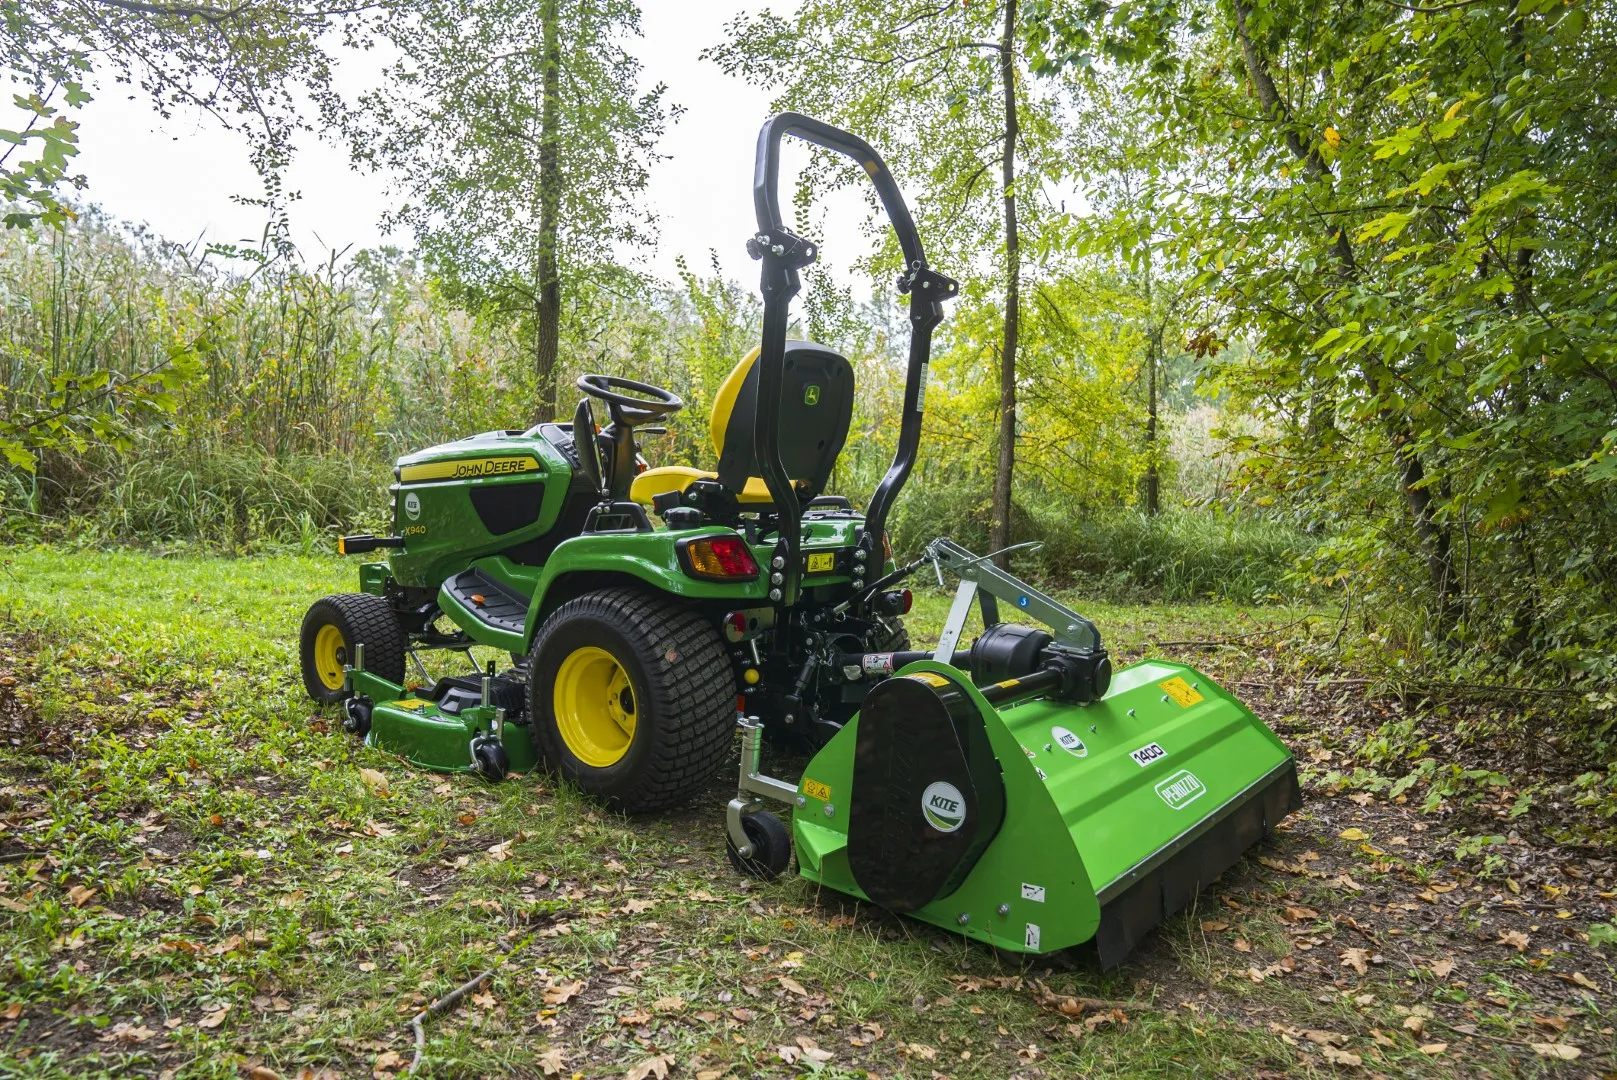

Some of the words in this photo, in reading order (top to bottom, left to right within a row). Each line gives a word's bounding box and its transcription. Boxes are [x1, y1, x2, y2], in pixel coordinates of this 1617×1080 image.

[452, 464, 483, 478] JOHN
[485, 460, 527, 474] DEERE
[404, 525, 427, 537] X940
[1059, 733, 1076, 746] KITE
[1133, 744, 1164, 764] 1400
[1161, 774, 1200, 805] PERUZZO
[929, 794, 960, 814] KITE
